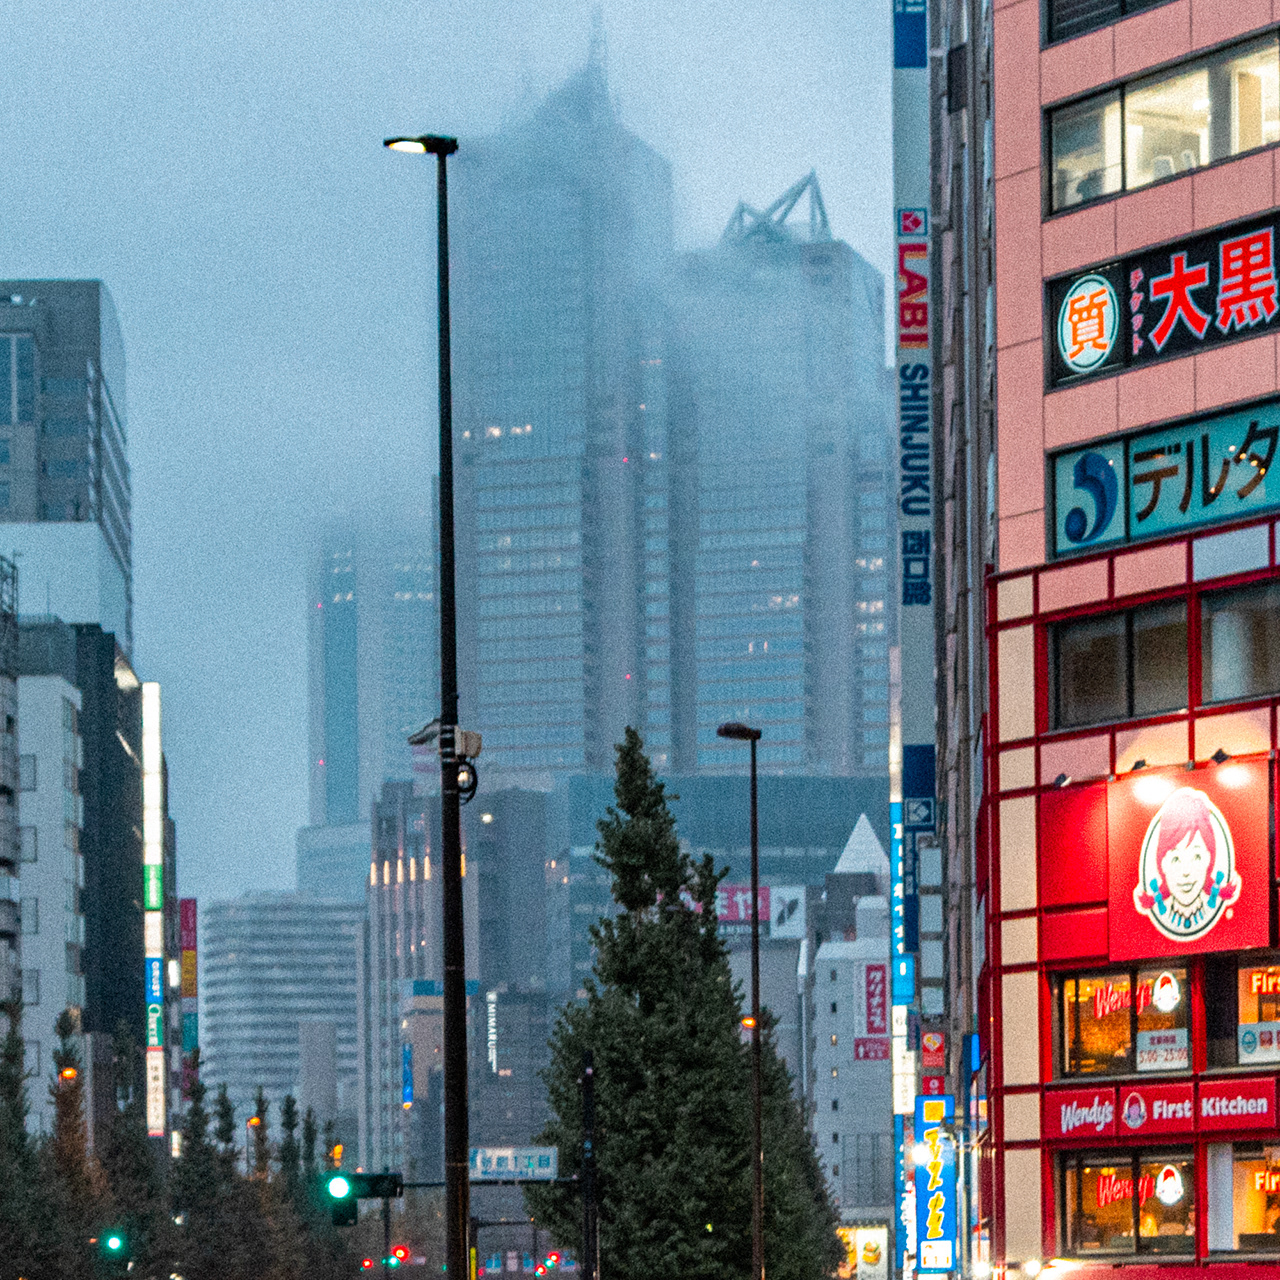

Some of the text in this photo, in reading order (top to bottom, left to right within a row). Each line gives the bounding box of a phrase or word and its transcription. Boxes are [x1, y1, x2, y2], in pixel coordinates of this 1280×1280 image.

[898, 243, 928, 348] LABI
[1067, 289, 1109, 360] 質
[900, 363, 930, 516] SHINJUKU
[1133, 420, 1279, 522] デルタ
[1061, 1095, 1268, 1133] Wendy's First Kitchen
